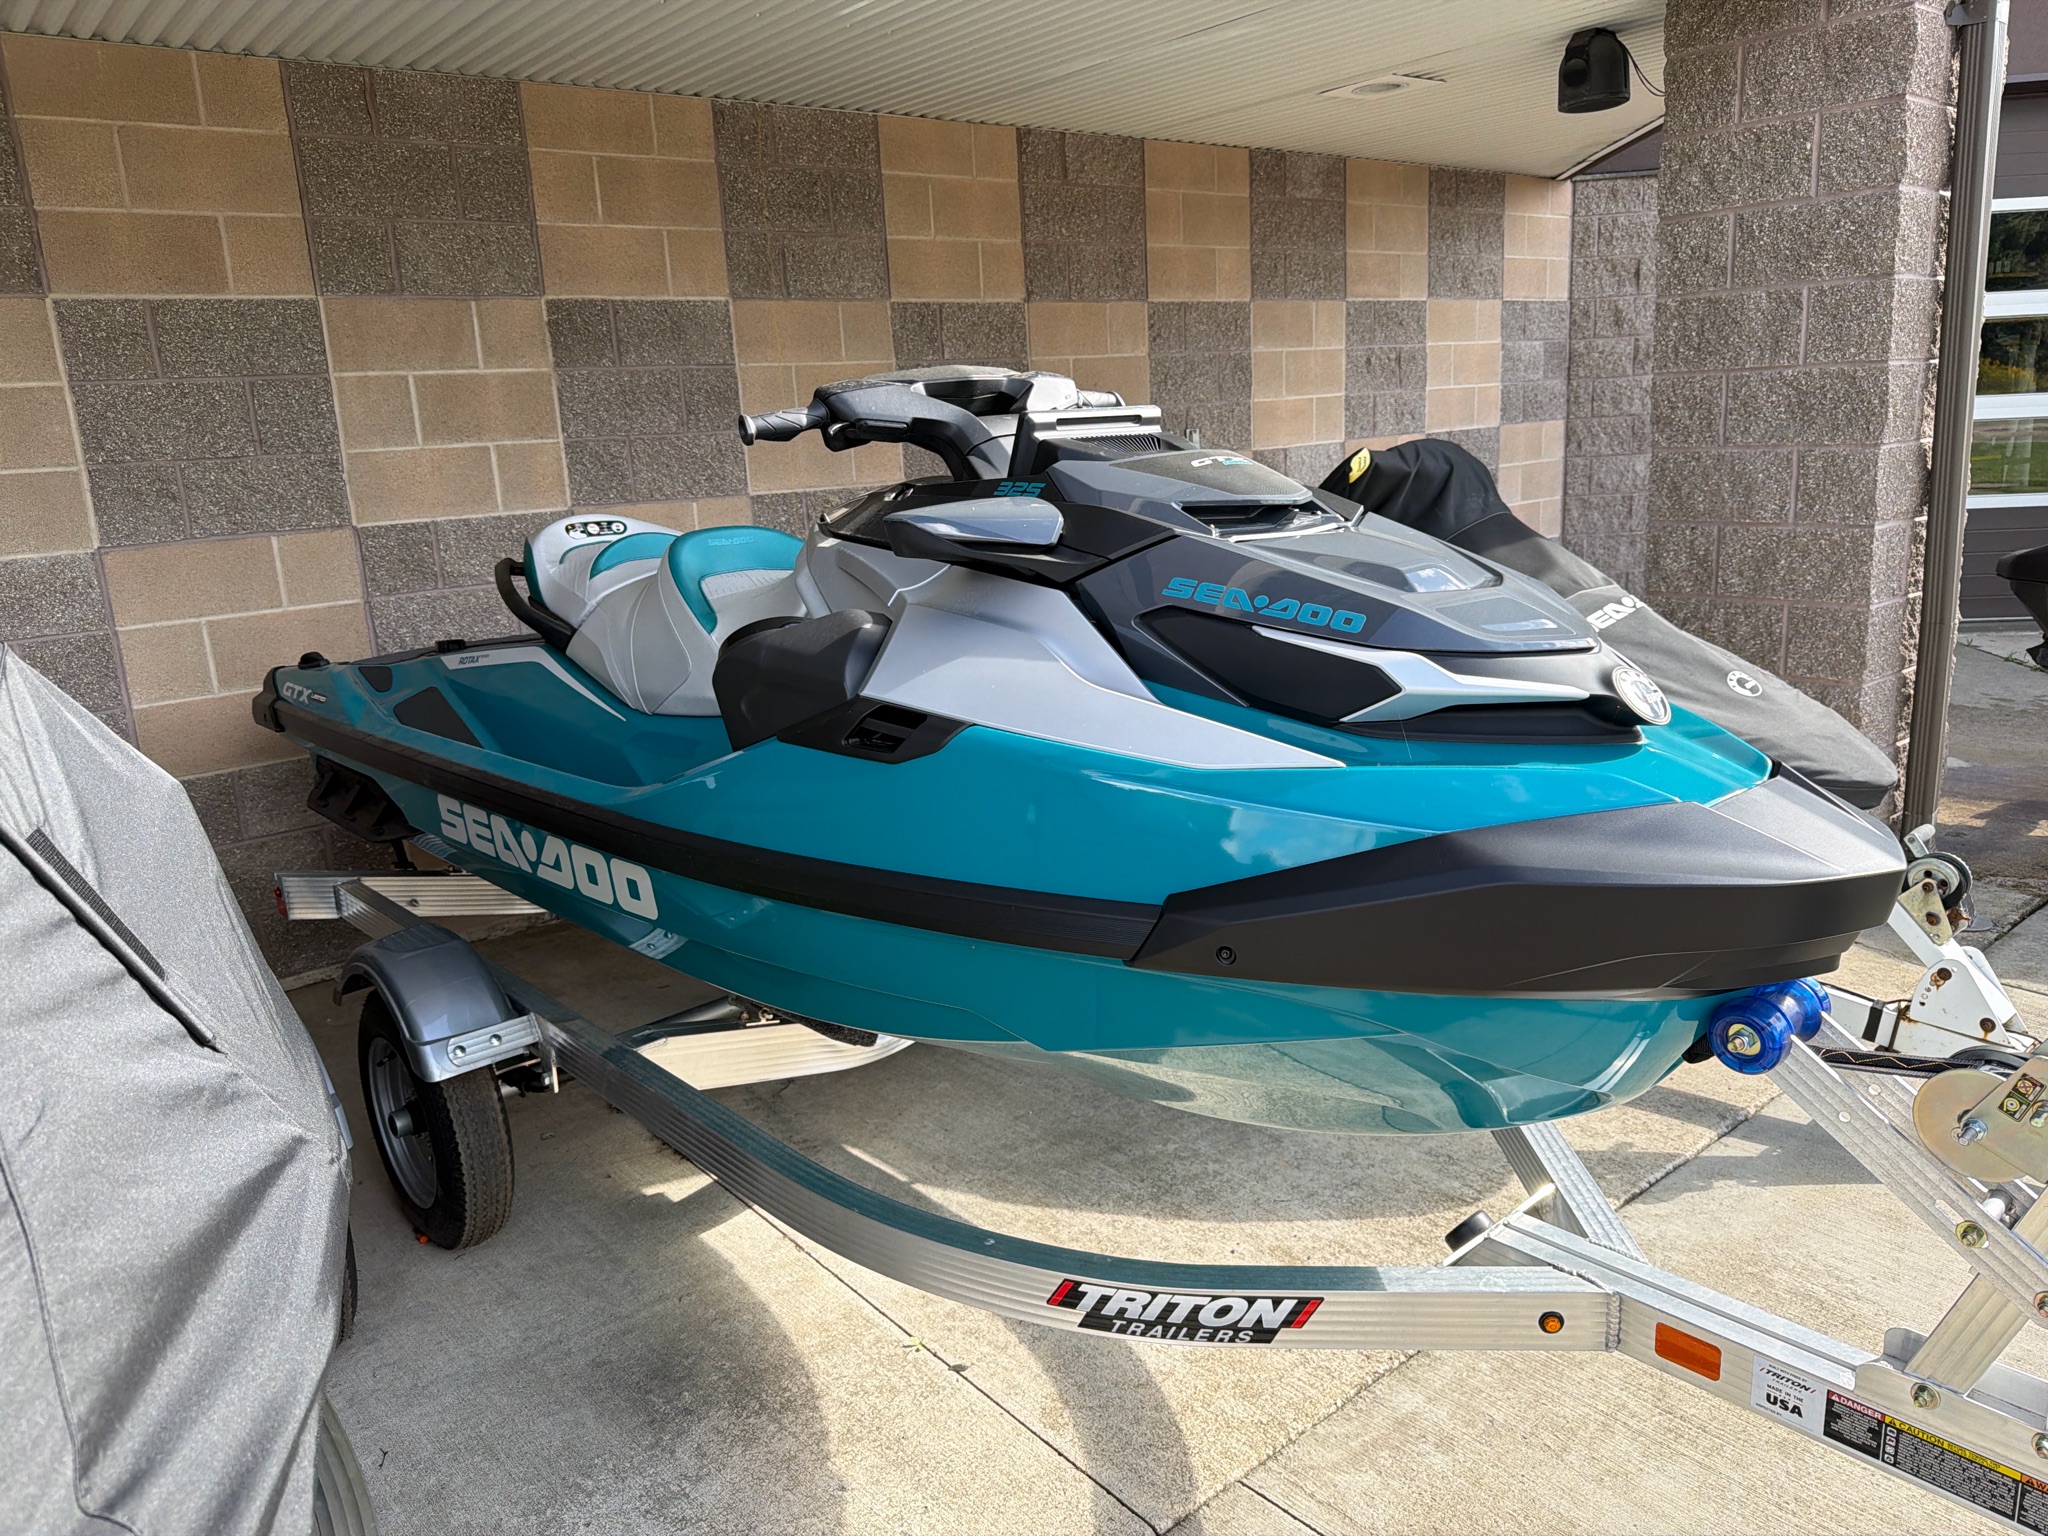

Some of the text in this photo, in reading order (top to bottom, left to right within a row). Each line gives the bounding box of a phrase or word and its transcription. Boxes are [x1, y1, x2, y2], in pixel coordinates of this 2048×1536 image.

[993, 481, 1047, 497] 325
[458, 655, 480, 665] ROTAX
[283, 681, 312, 704] GTX
[1075, 1283, 1298, 1328] TRITON
[1111, 1320, 1254, 1343] TRAILERS
[1765, 1368, 1812, 1391] TRITON
[1772, 1378, 1803, 1393] TRAILERS
[1766, 1383, 1783, 1394] MADE
[1793, 1395, 1804, 1403] THE
[1766, 1392, 1803, 1419] USA
[1840, 1397, 1881, 1420] DANGER
[1899, 1422, 1944, 1447] CAUTION
